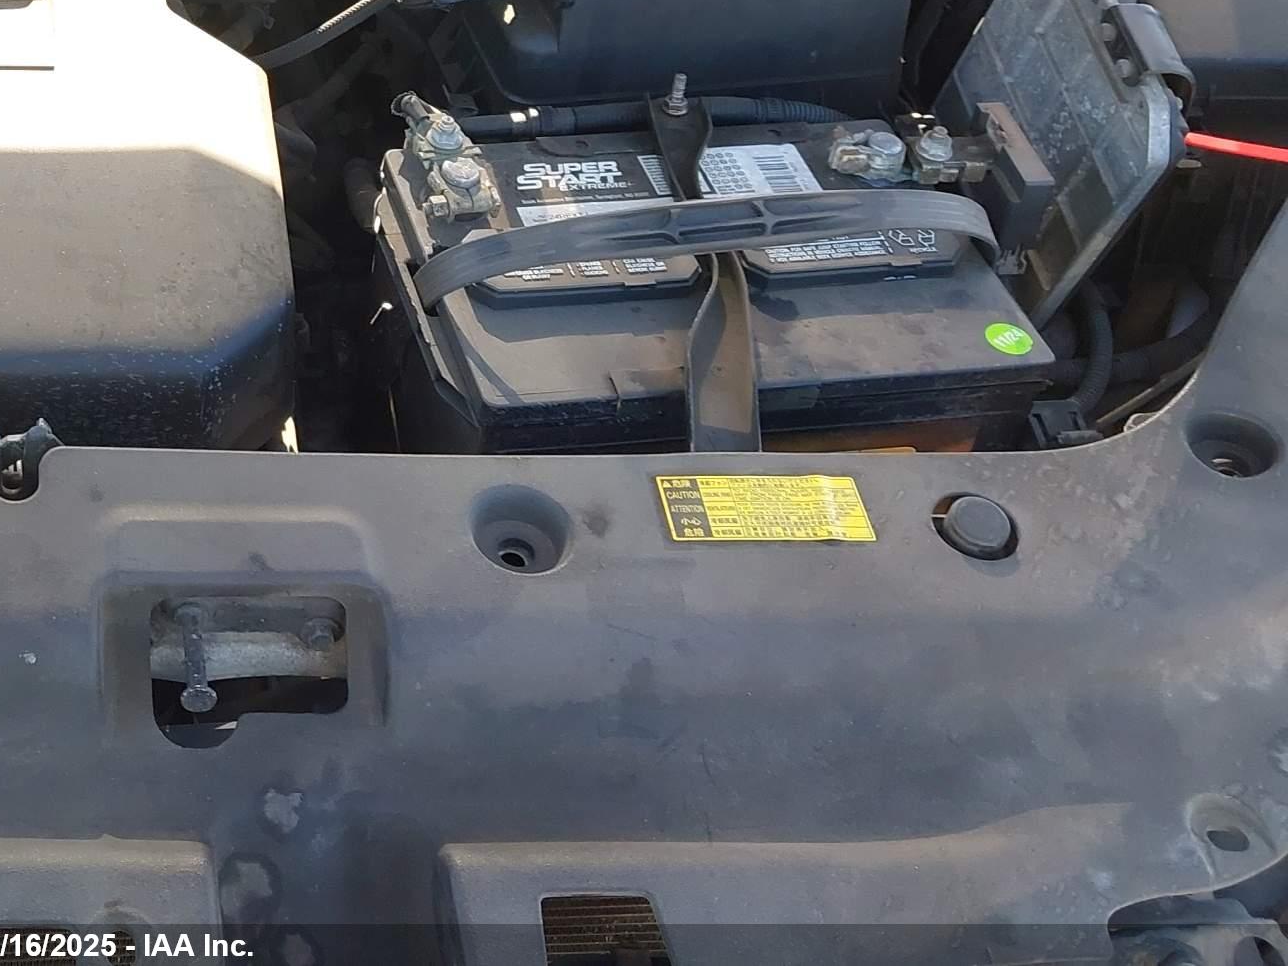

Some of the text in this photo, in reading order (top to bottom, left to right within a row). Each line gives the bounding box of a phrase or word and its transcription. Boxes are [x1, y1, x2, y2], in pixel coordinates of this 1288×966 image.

[523, 161, 618, 176] SUPER
[517, 172, 623, 191] START
[666, 491, 700, 500] CAUTION
[671, 504, 704, 513] ATTENTION
